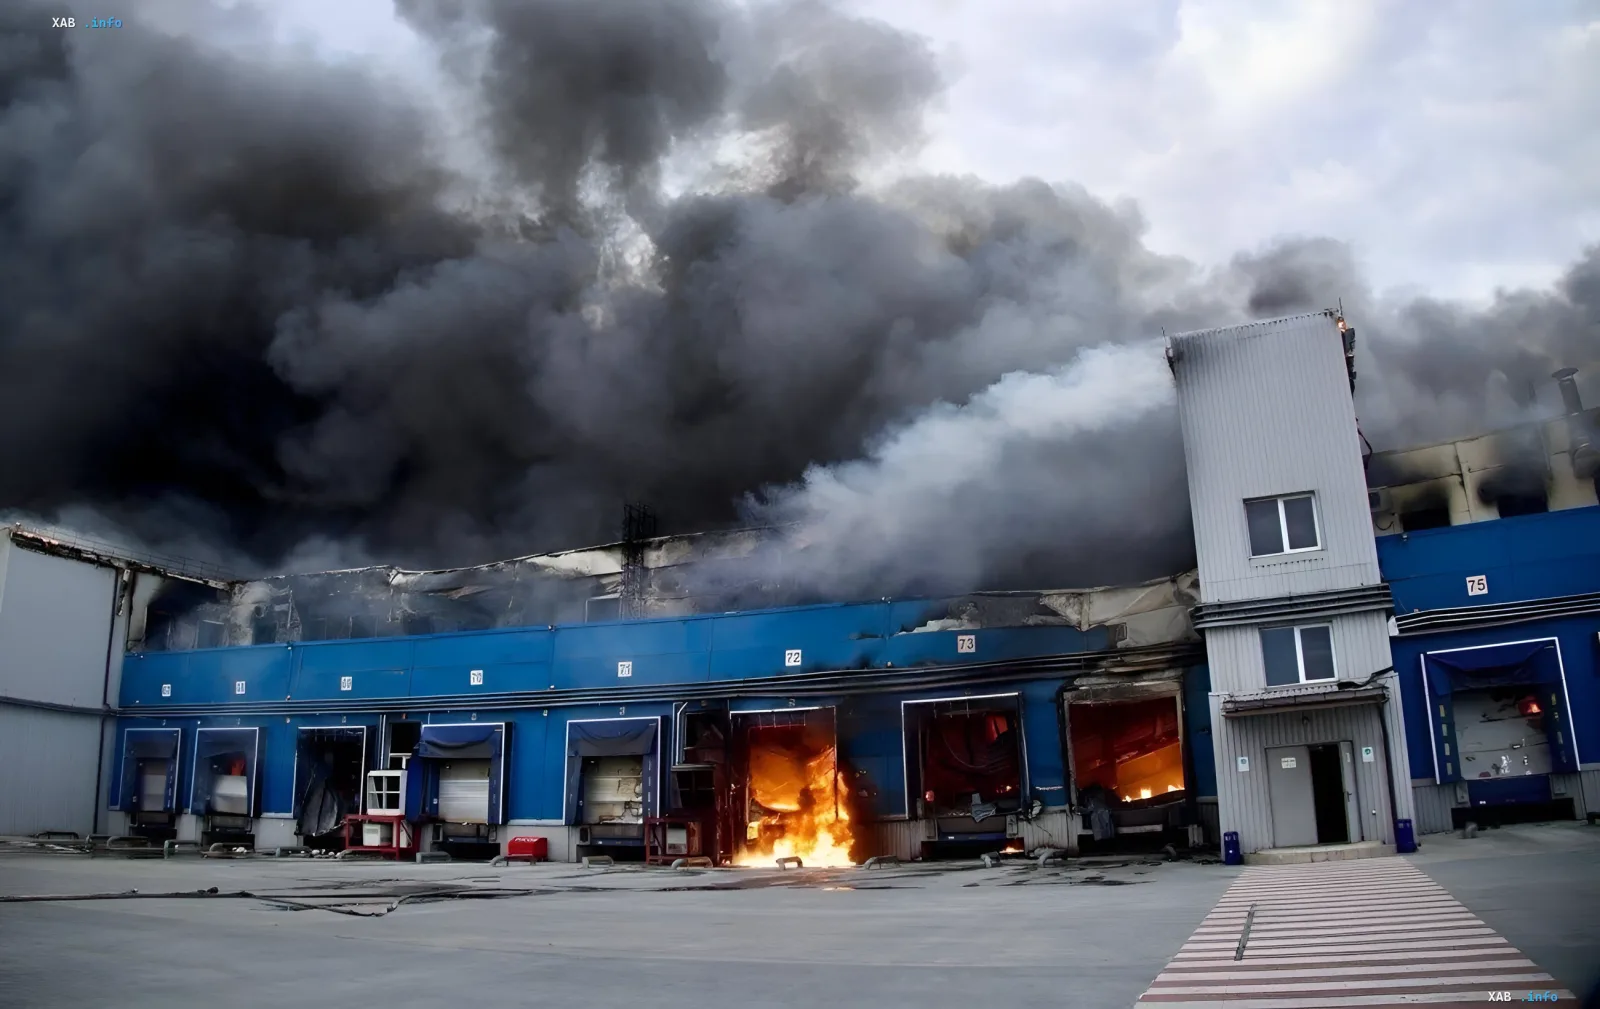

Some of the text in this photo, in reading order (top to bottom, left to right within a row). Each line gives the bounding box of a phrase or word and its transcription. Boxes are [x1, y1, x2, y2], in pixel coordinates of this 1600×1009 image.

[1468, 579, 1486, 594] 75
[959, 638, 974, 650] 73
[787, 652, 800, 663] 72
[619, 663, 631, 675] 71
